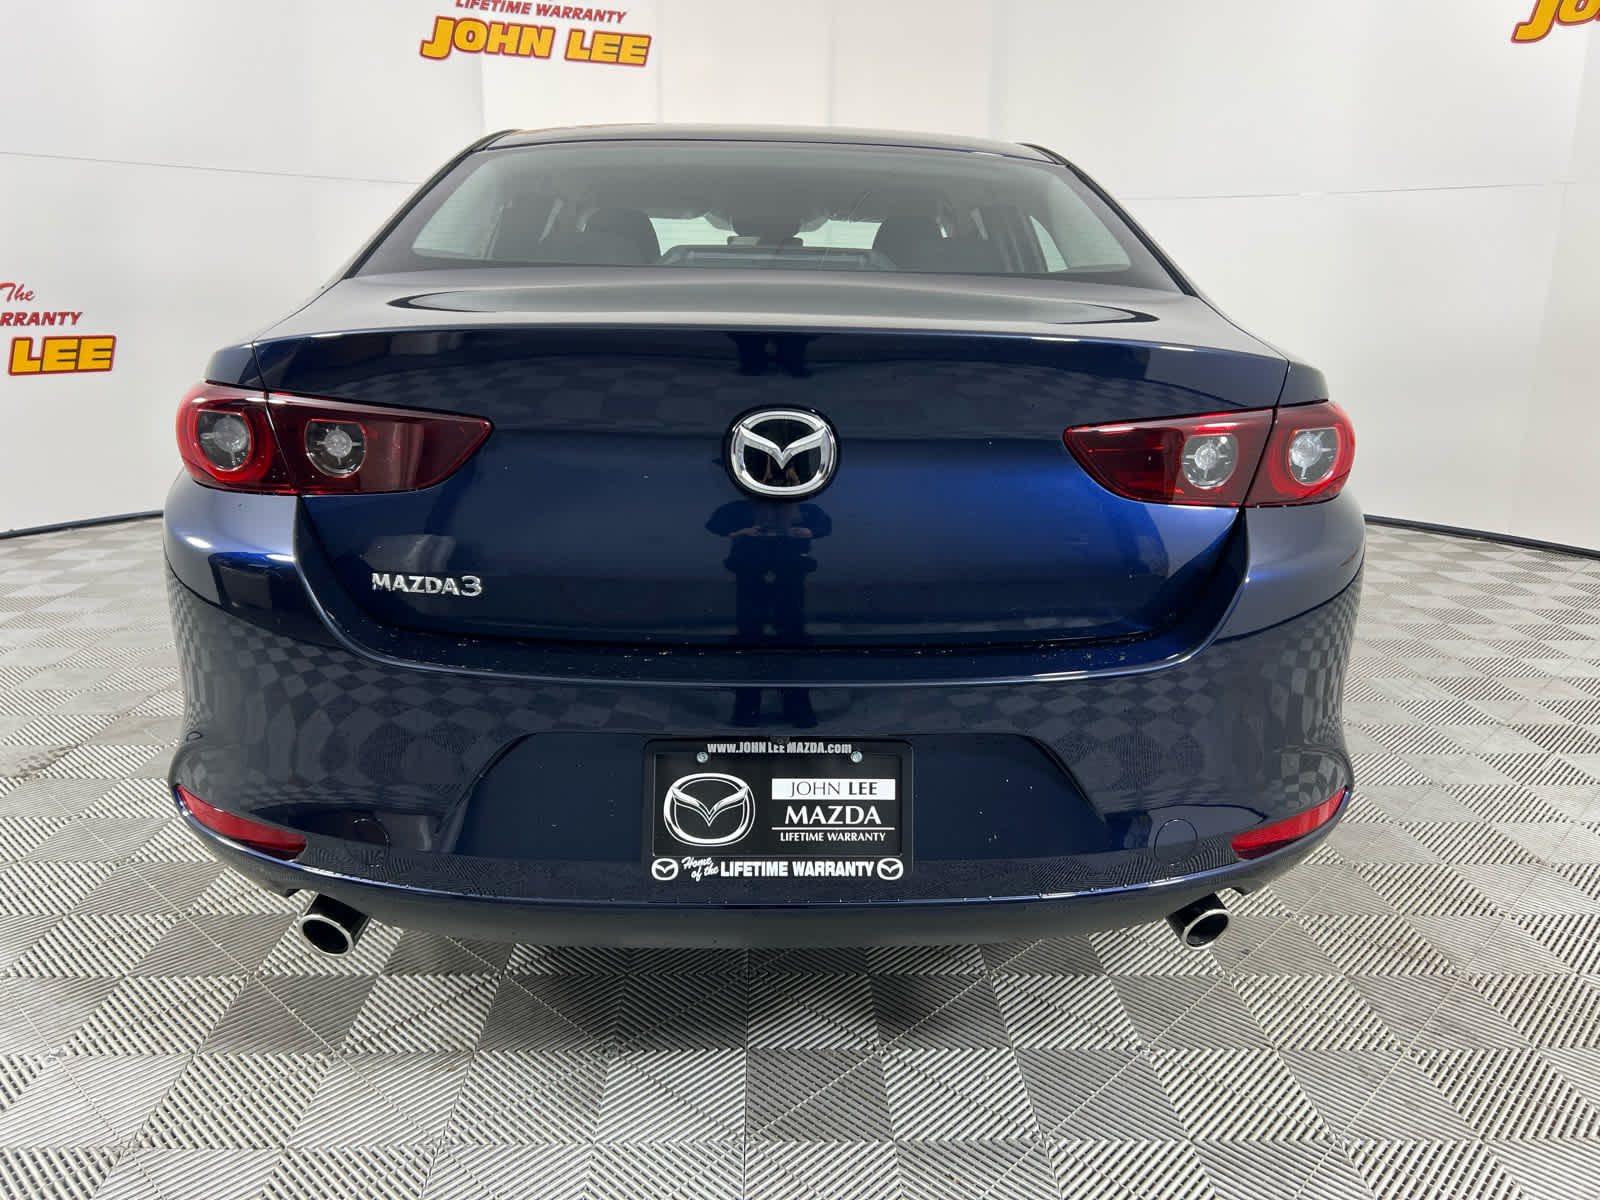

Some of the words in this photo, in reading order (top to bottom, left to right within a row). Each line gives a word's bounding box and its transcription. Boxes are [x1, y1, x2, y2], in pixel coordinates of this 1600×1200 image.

[536, 3, 627, 24] WARRANTY
[420, 16, 556, 60] JOHN
[564, 28, 652, 67] LEE
[0, 282, 35, 302] The
[8, 334, 117, 376] LEE
[371, 572, 483, 597] MAZDA3
[790, 781, 841, 797] JOHN
[848, 781, 878, 796] LEE
[784, 805, 882, 825] MAZDA
[780, 832, 825, 842] LIFETIME
[827, 832, 886, 843] WARRANTY
[681, 856, 713, 870] Home
[691, 868, 704, 882] of
[703, 862, 720, 877] the
[720, 861, 789, 877] LIFETIME
[792, 861, 875, 877] WARRANTY
